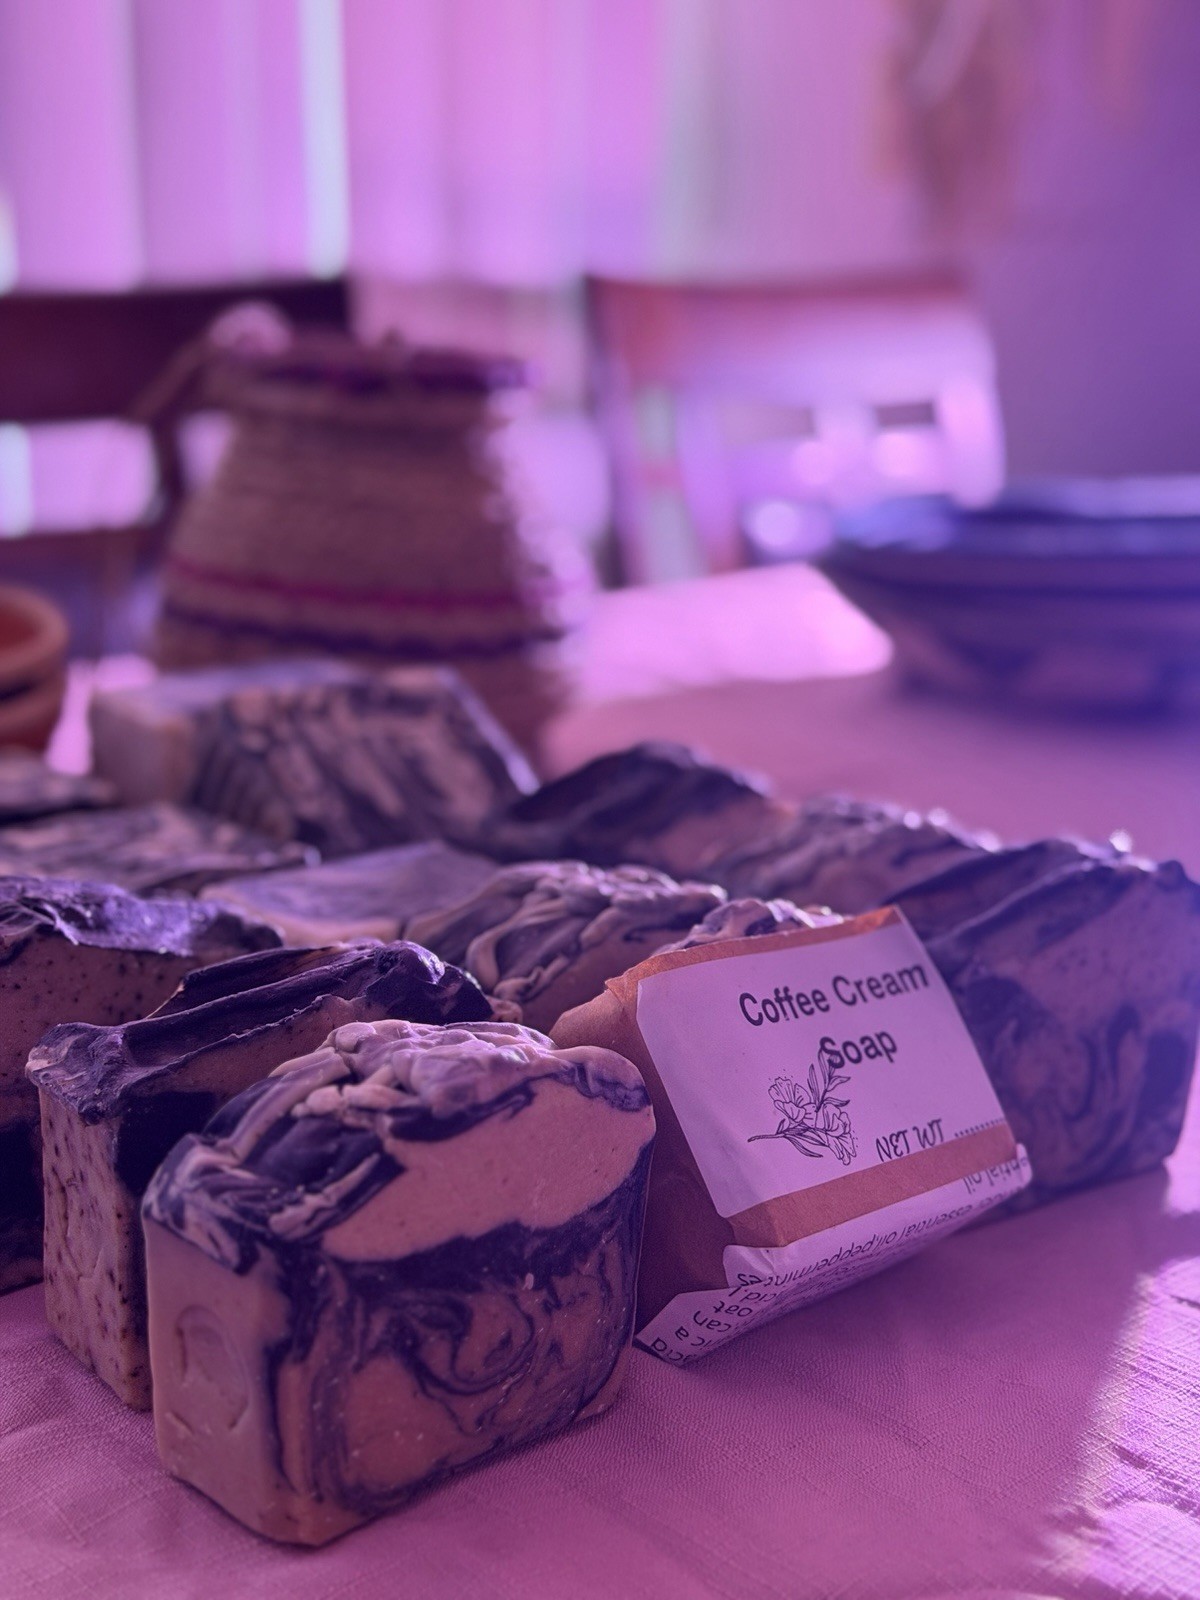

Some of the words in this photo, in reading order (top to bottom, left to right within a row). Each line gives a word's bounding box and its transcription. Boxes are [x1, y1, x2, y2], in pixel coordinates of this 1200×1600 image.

[739, 986, 830, 1026] Coffee
[832, 964, 929, 1006] Cream
[819, 1031, 897, 1069] Soap
[875, 1130, 911, 1162] NET
[913, 1118, 945, 1149] WT
